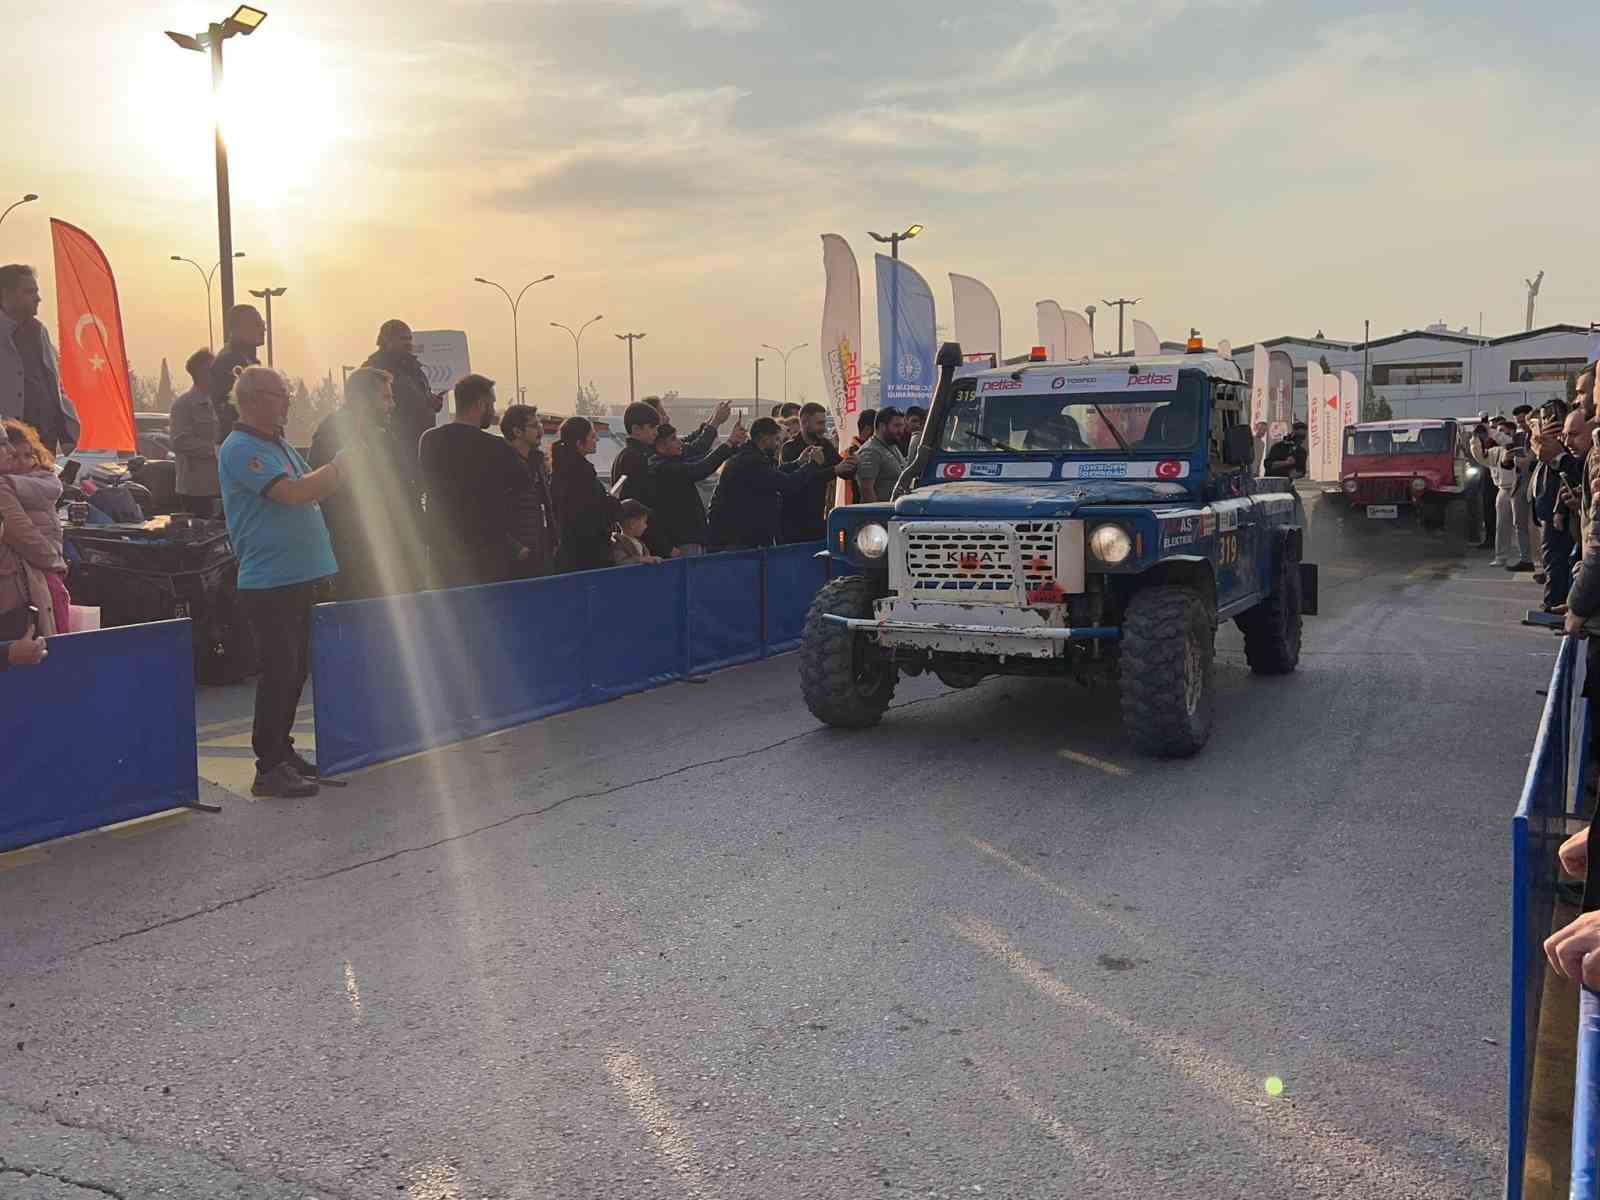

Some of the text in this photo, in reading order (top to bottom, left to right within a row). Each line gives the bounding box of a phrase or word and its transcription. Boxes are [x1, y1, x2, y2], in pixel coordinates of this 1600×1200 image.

[981, 376, 1023, 392] petlas
[1128, 371, 1173, 387] petlas
[956, 390, 976, 401] 319
[947, 551, 1006, 562] KIRAT
[1219, 534, 1238, 564] 319
